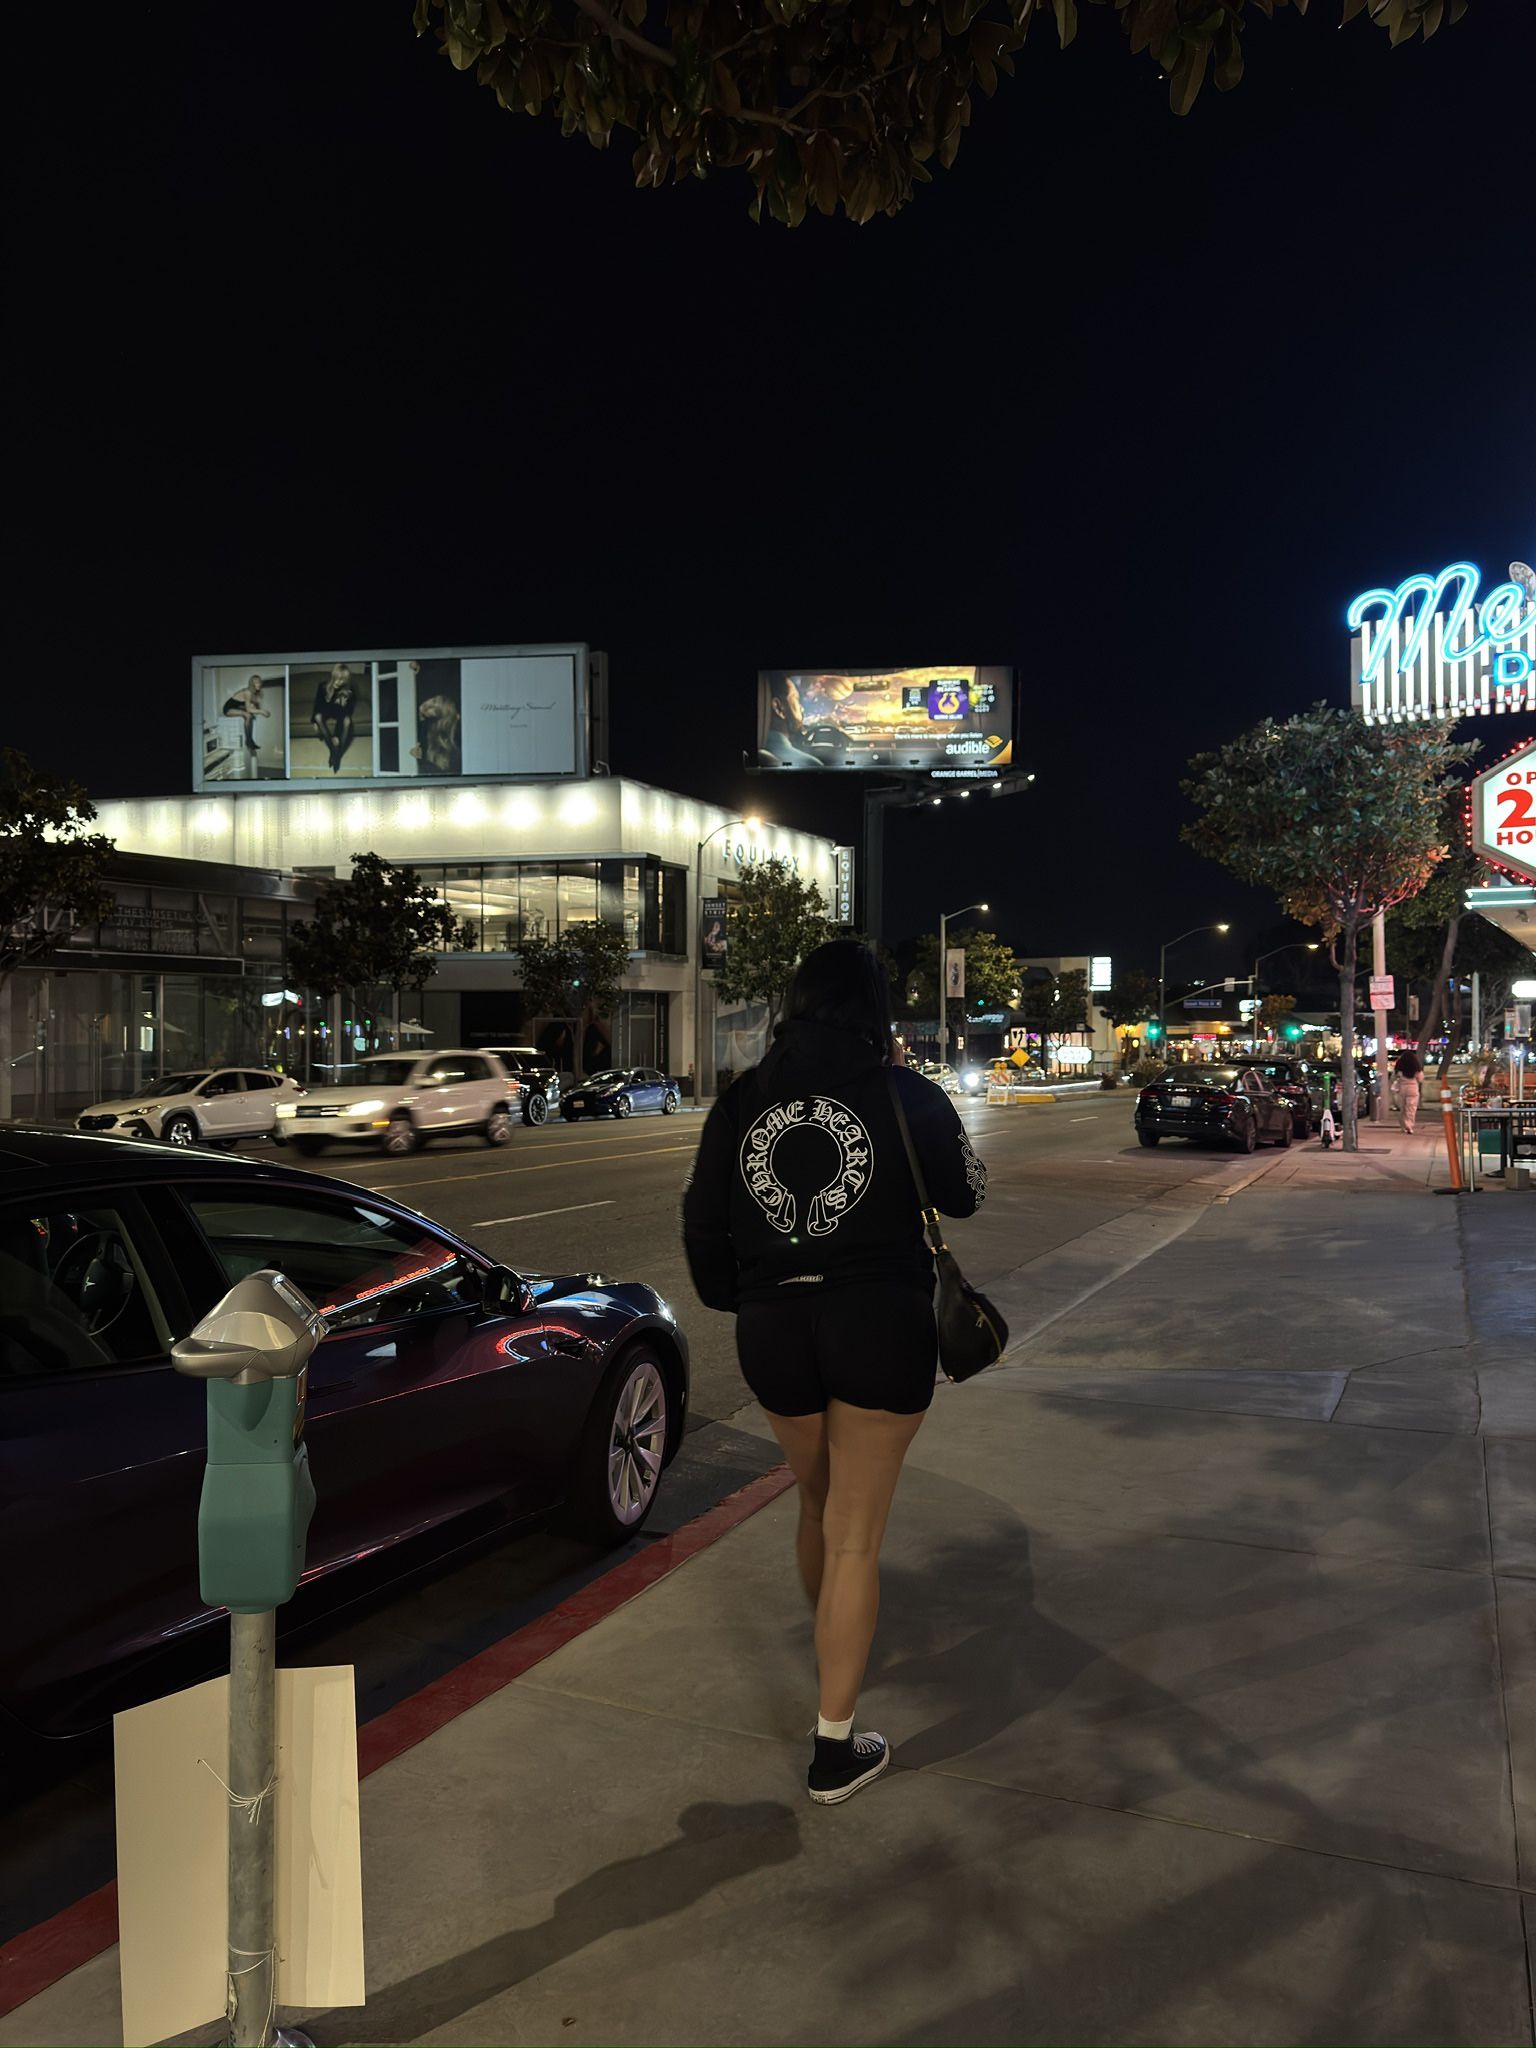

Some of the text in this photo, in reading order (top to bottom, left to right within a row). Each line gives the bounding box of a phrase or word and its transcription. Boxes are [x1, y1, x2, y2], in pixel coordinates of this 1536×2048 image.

[1346, 561, 1536, 685] Me
[945, 740, 990, 755] audible
[1496, 788, 1536, 829] 2
[1496, 830, 1536, 846] HO
[841, 851, 850, 921] EQUINOX
[746, 1099, 869, 1211] CHROME HEARTS
